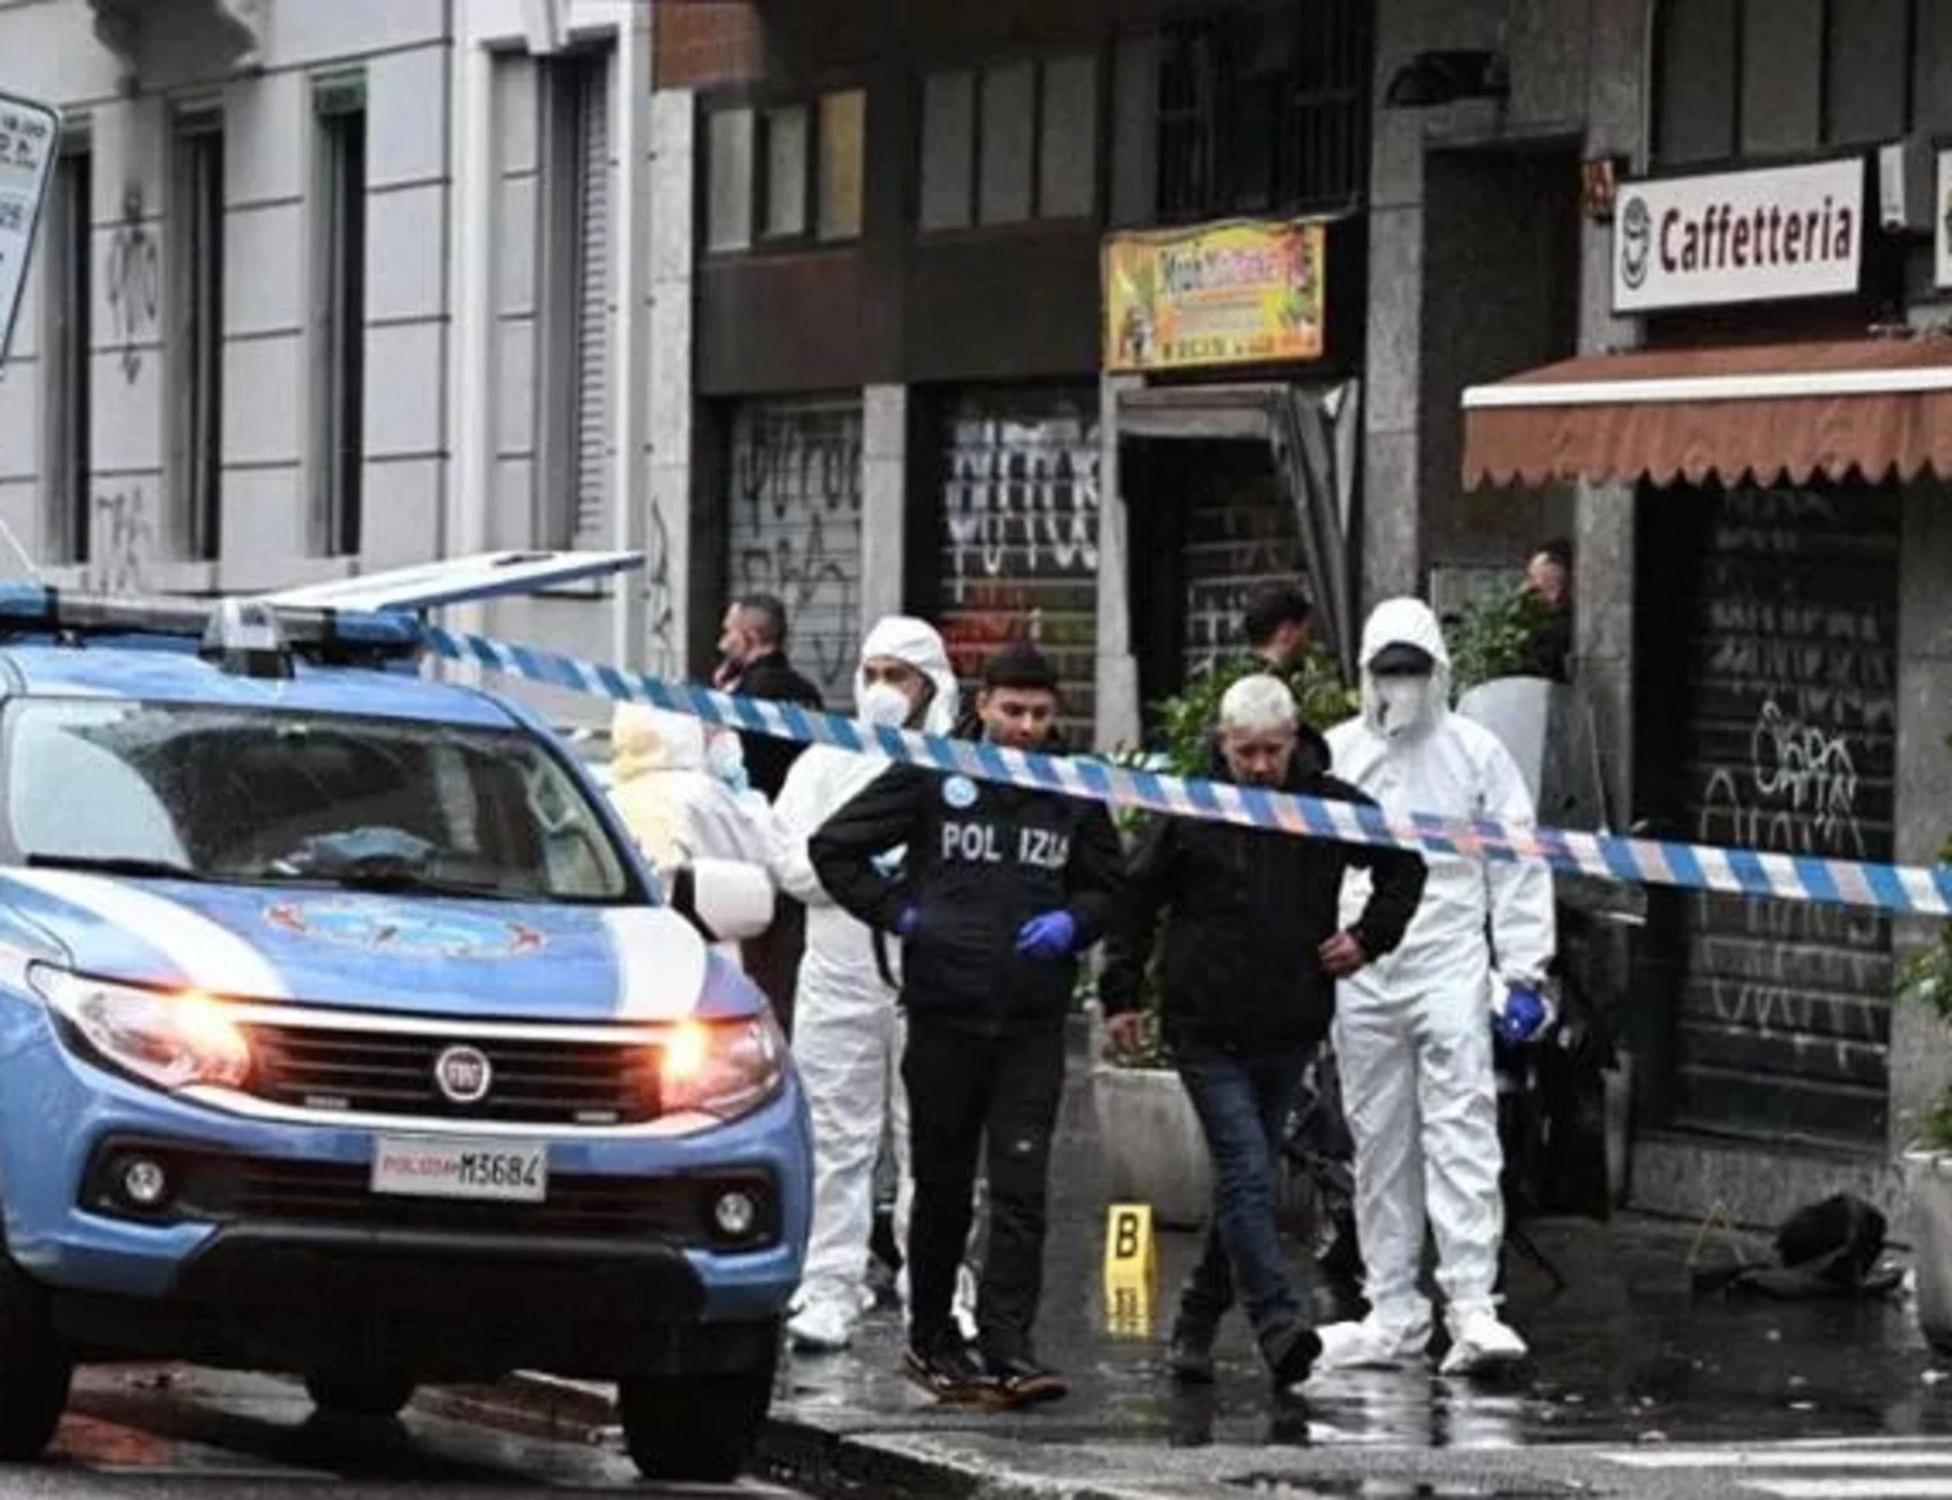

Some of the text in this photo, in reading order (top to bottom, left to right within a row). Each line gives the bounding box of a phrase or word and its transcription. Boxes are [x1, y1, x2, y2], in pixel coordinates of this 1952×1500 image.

[1659, 195, 1853, 273] Caffetteria
[458, 1152, 540, 1187] M3684
[1116, 1212, 1139, 1259] B
